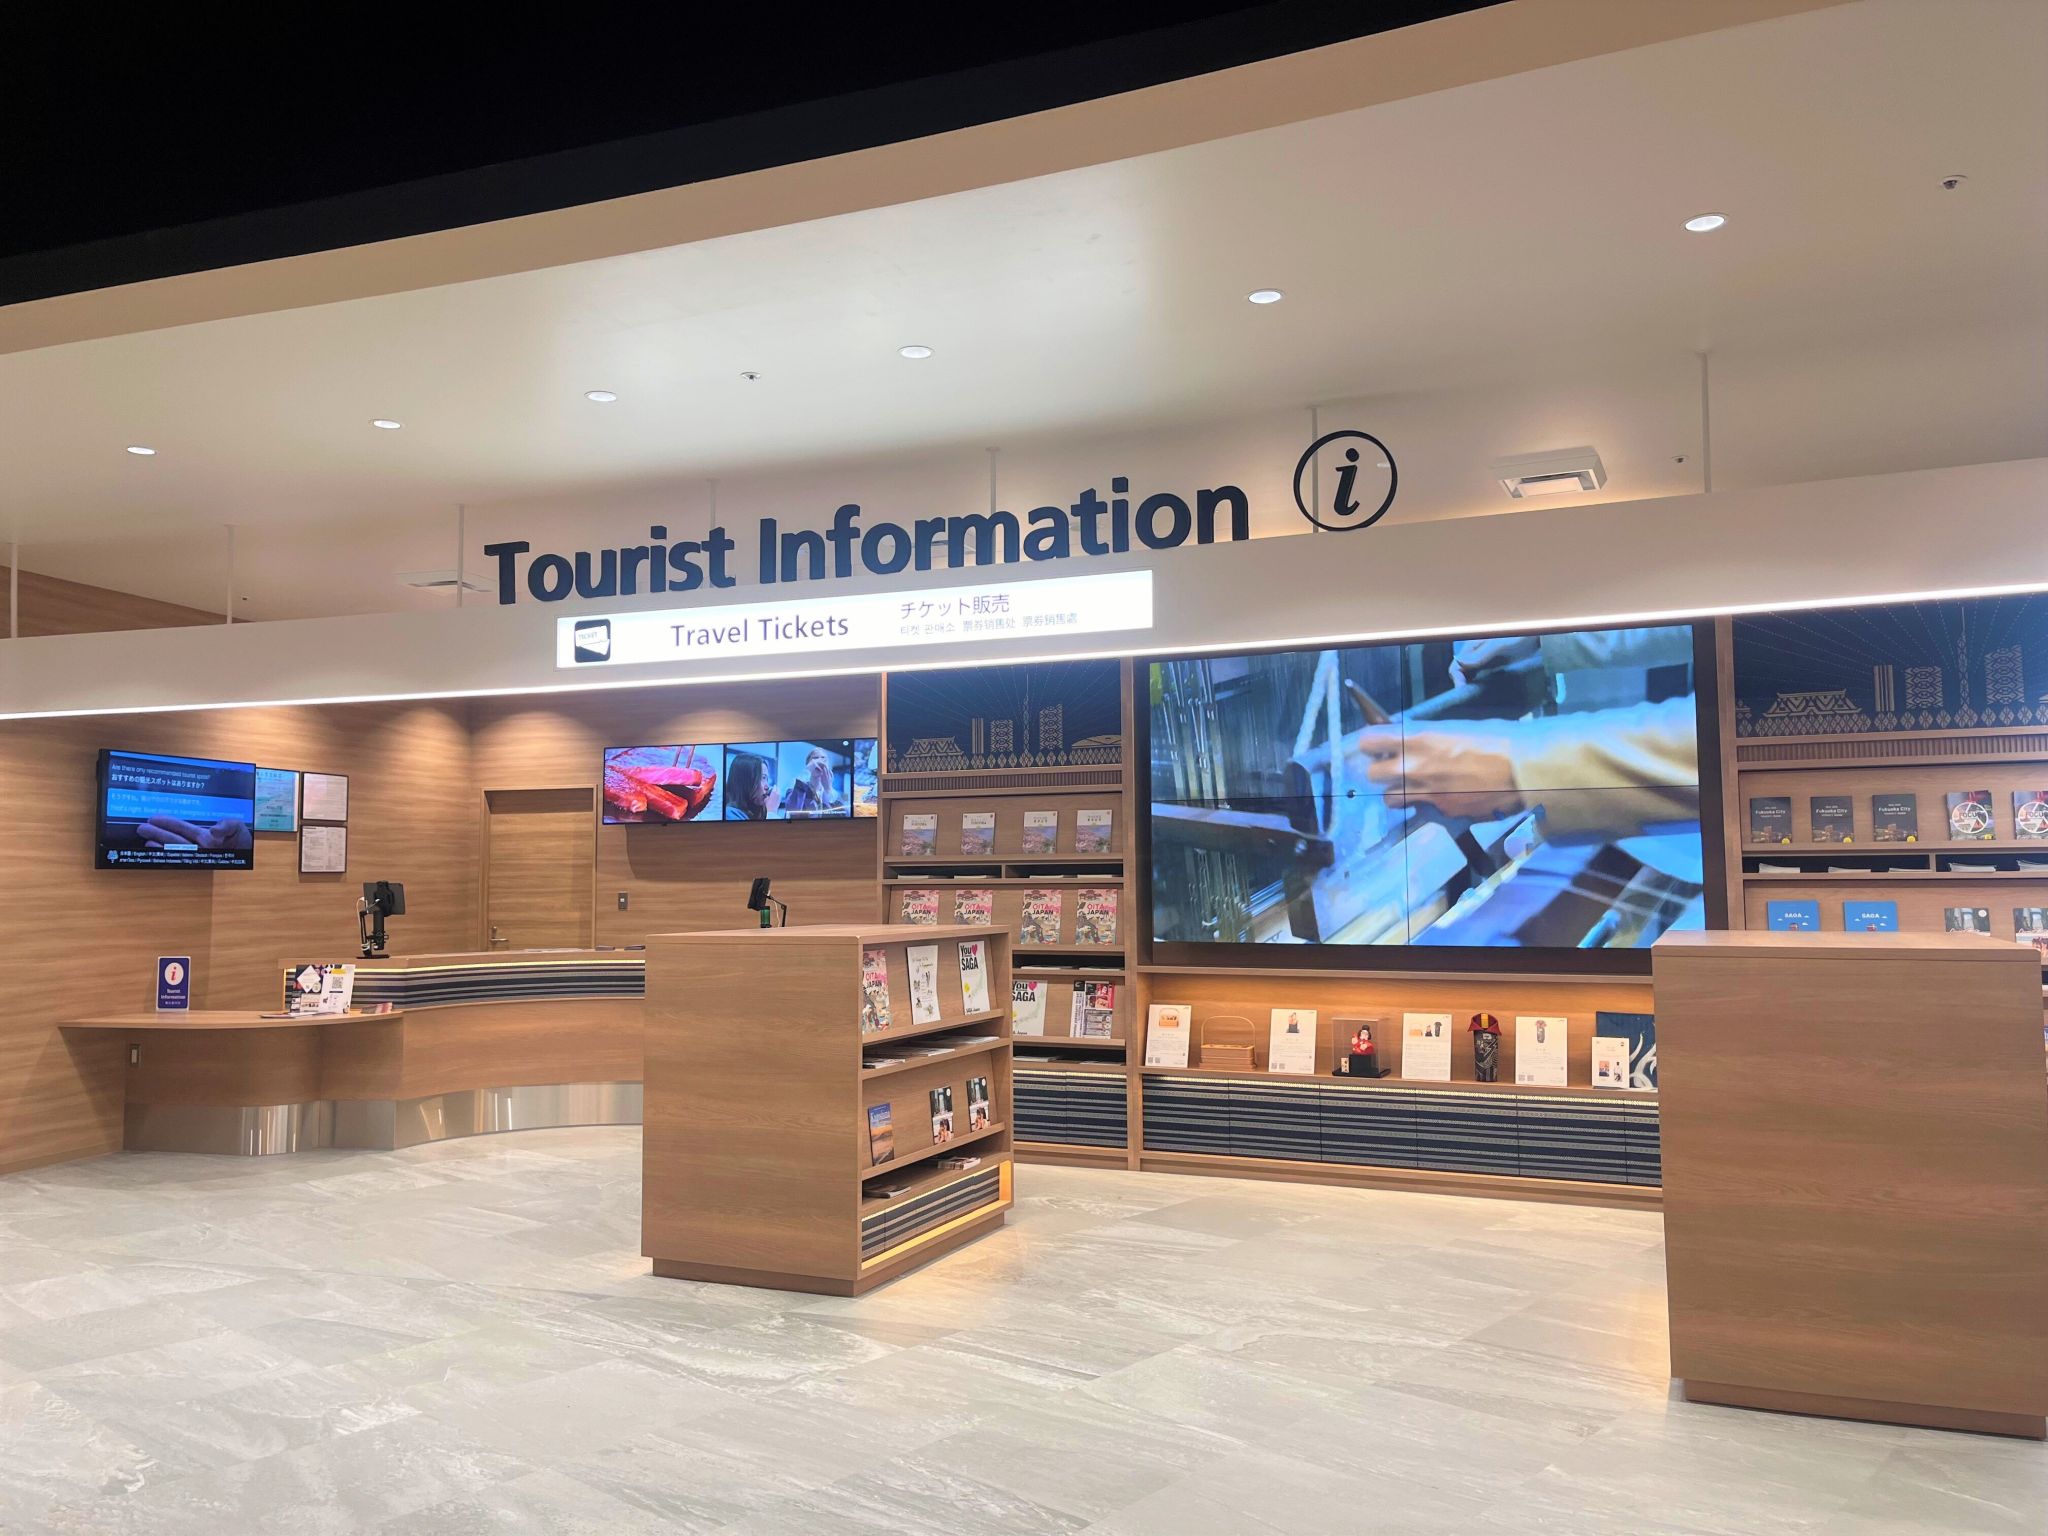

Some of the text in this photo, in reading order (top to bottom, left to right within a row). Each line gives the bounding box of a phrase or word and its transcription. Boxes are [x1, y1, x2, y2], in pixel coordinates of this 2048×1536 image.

[484, 477, 1249, 605] Tourist Information
[901, 594, 1010, 619] チケット販売
[671, 614, 849, 647] Travel Tickets
[960, 945, 972, 957] You
[961, 957, 979, 971] SAGA
